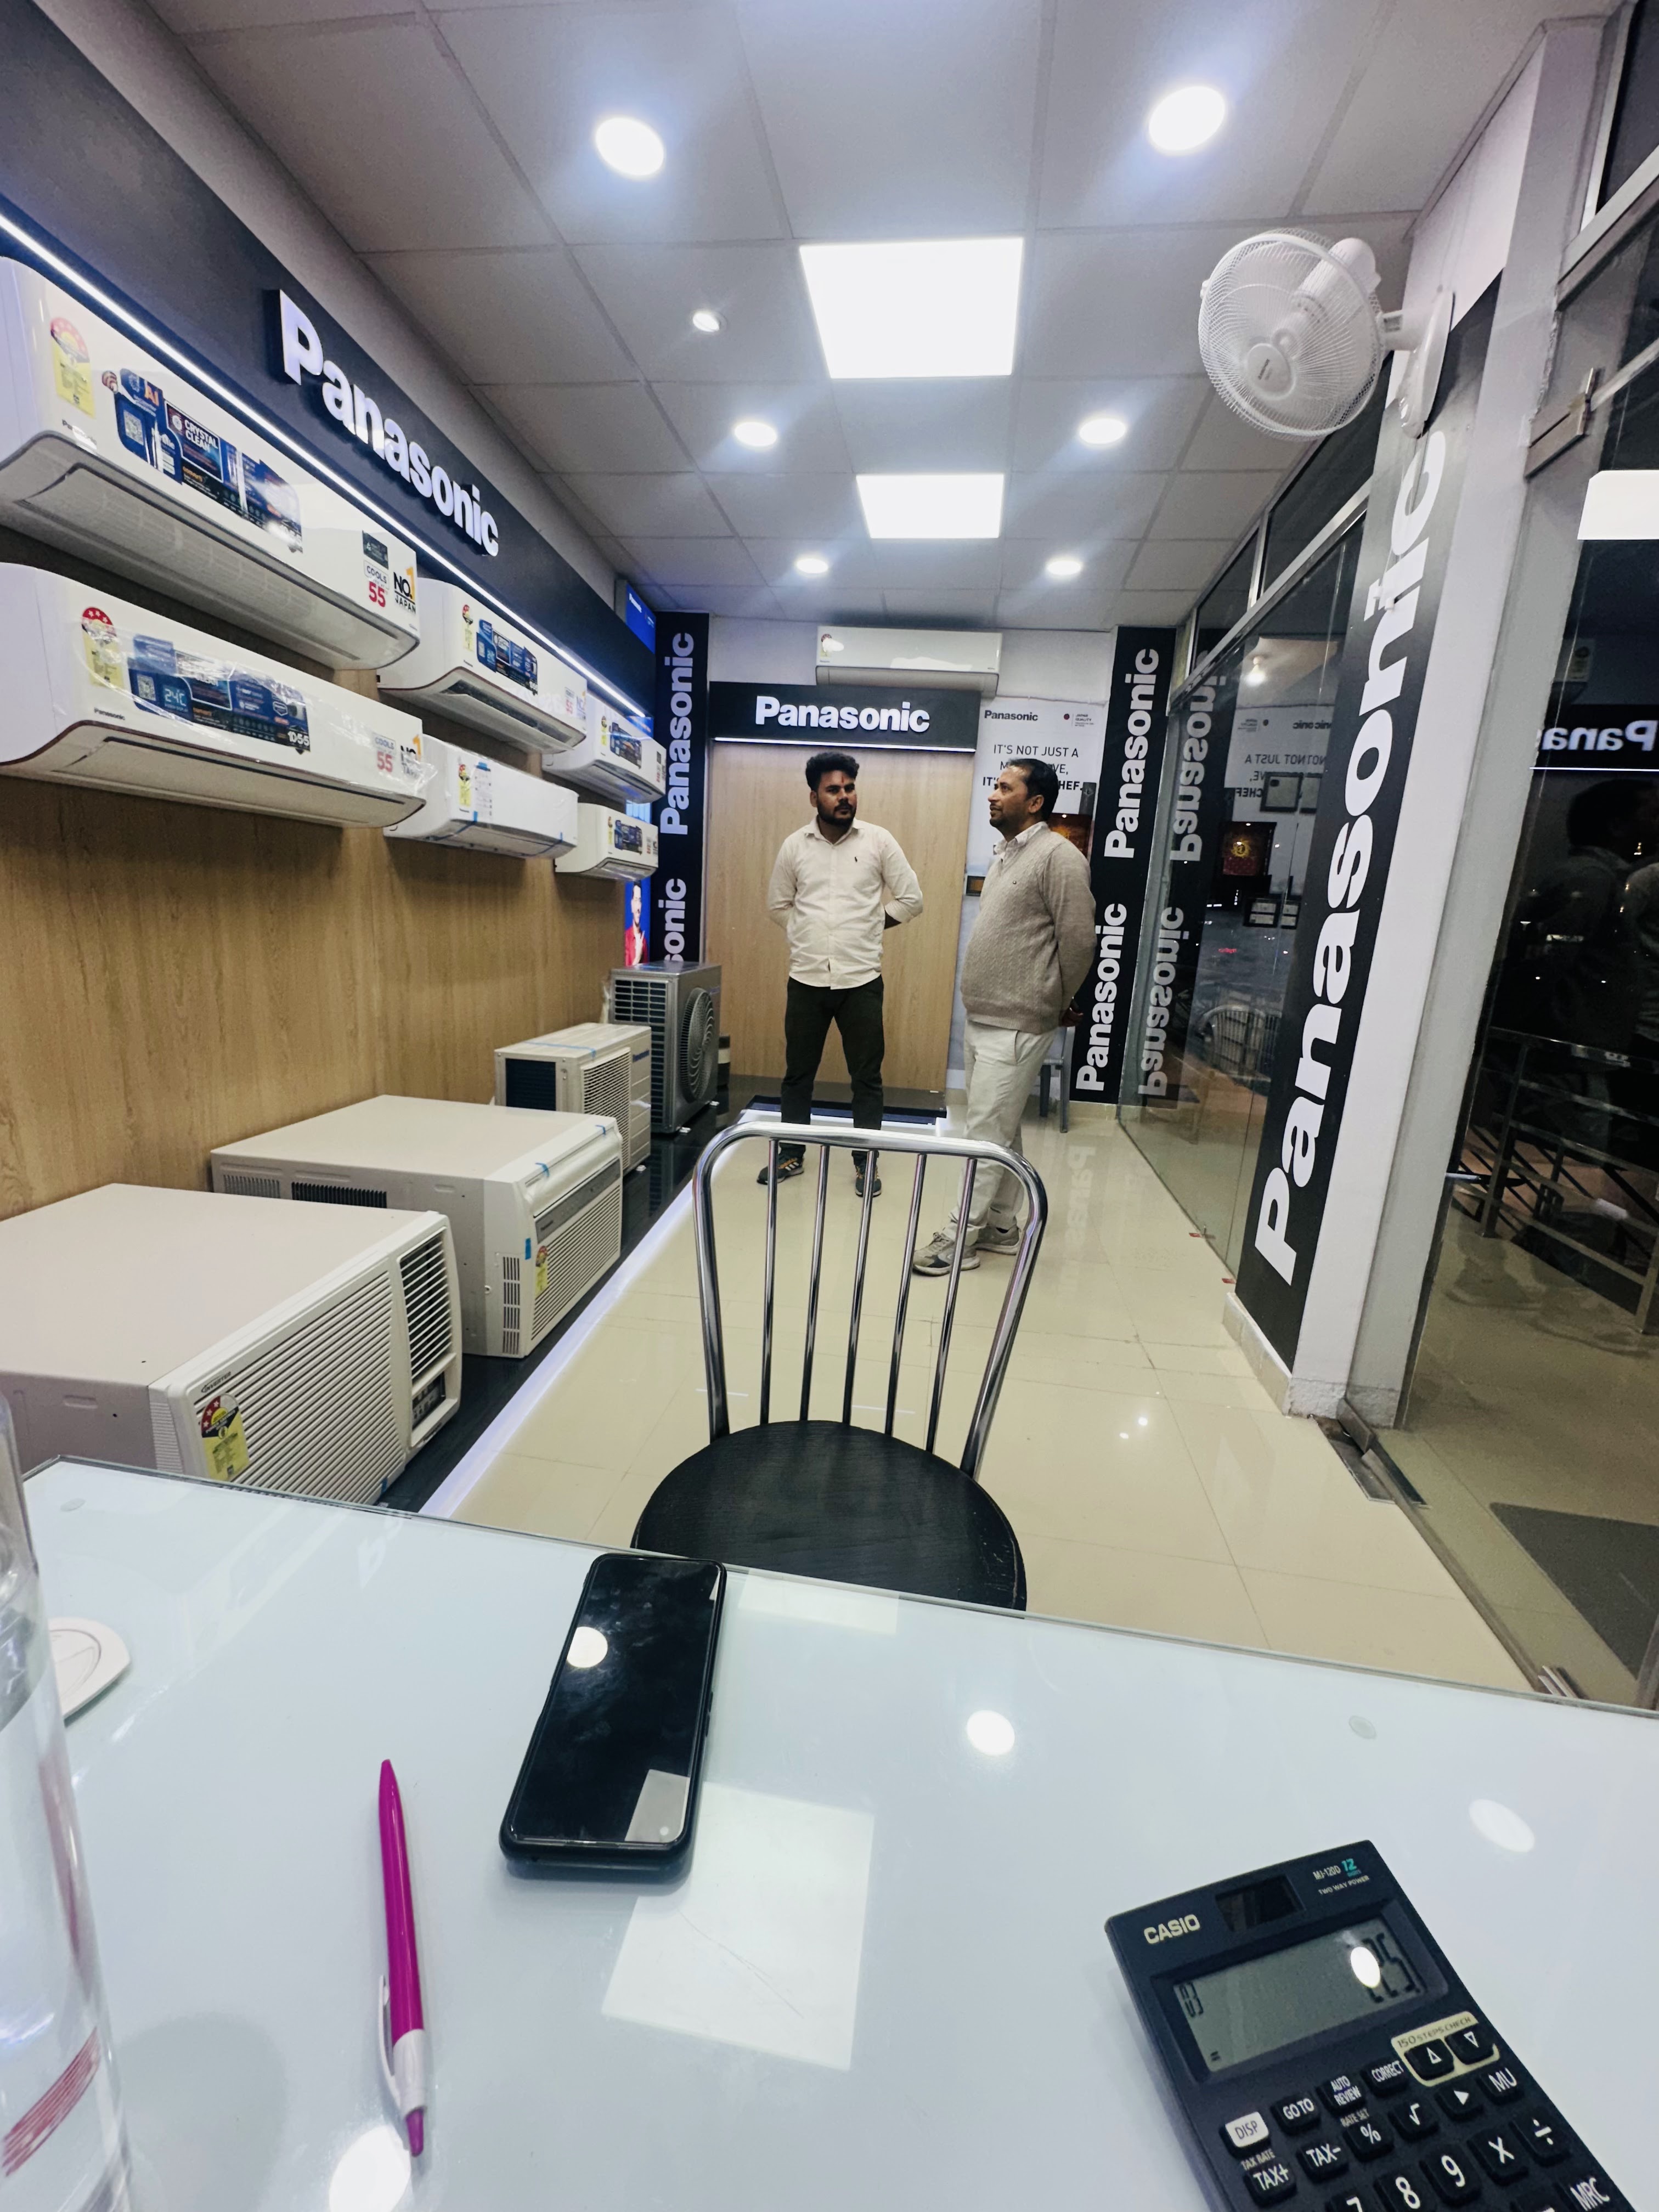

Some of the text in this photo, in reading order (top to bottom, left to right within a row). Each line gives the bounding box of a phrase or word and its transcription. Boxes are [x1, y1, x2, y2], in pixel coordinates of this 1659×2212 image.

[184, 419, 218, 449] CRYSTAL
[280, 289, 499, 556] Panasonic
[185, 430, 211, 453] CLEAN
[366, 566, 387, 584] COOLS
[395, 594, 416, 614] JAPAN
[755, 696, 930, 733] Panasonic
[984, 710, 1038, 721] Panasonic
[661, 632, 694, 835] Panasonic
[994, 744, 1079, 758] IT'S NOT JUST A
[1104, 648, 1159, 858] Panasonic
[983, 777, 1083, 791] IT' HEF.
[1254, 431, 1446, 1285] Panasonic
[1076, 903, 1127, 1091] Panasonic
[1341, 1858, 1357, 1872] 12
[1318, 1875, 1370, 1895] TWO WAY POWER
[1143, 1914, 1201, 1945] CASIO
[1397, 2036, 1417, 2049] 150
[1444, 2016, 1472, 2032] CHECK
[1371, 2060, 1404, 2083] CORRECT
[1488, 2068, 1517, 2092] MU
[1330, 2075, 1351, 2092] AUTO
[1334, 2085, 1362, 2106] REVIEW
[1282, 2098, 1314, 2120] GO TO
[1340, 2108, 1370, 2128] RATE SET
[1234, 2120, 1259, 2140] DISP
[1360, 2123, 1381, 2144] %
[1240, 2148, 1276, 2171] TAX RATE
[1441, 2154, 1466, 2188] 9
[1395, 2176, 1421, 2209] 8
[1570, 2177, 1610, 2211] MRC
